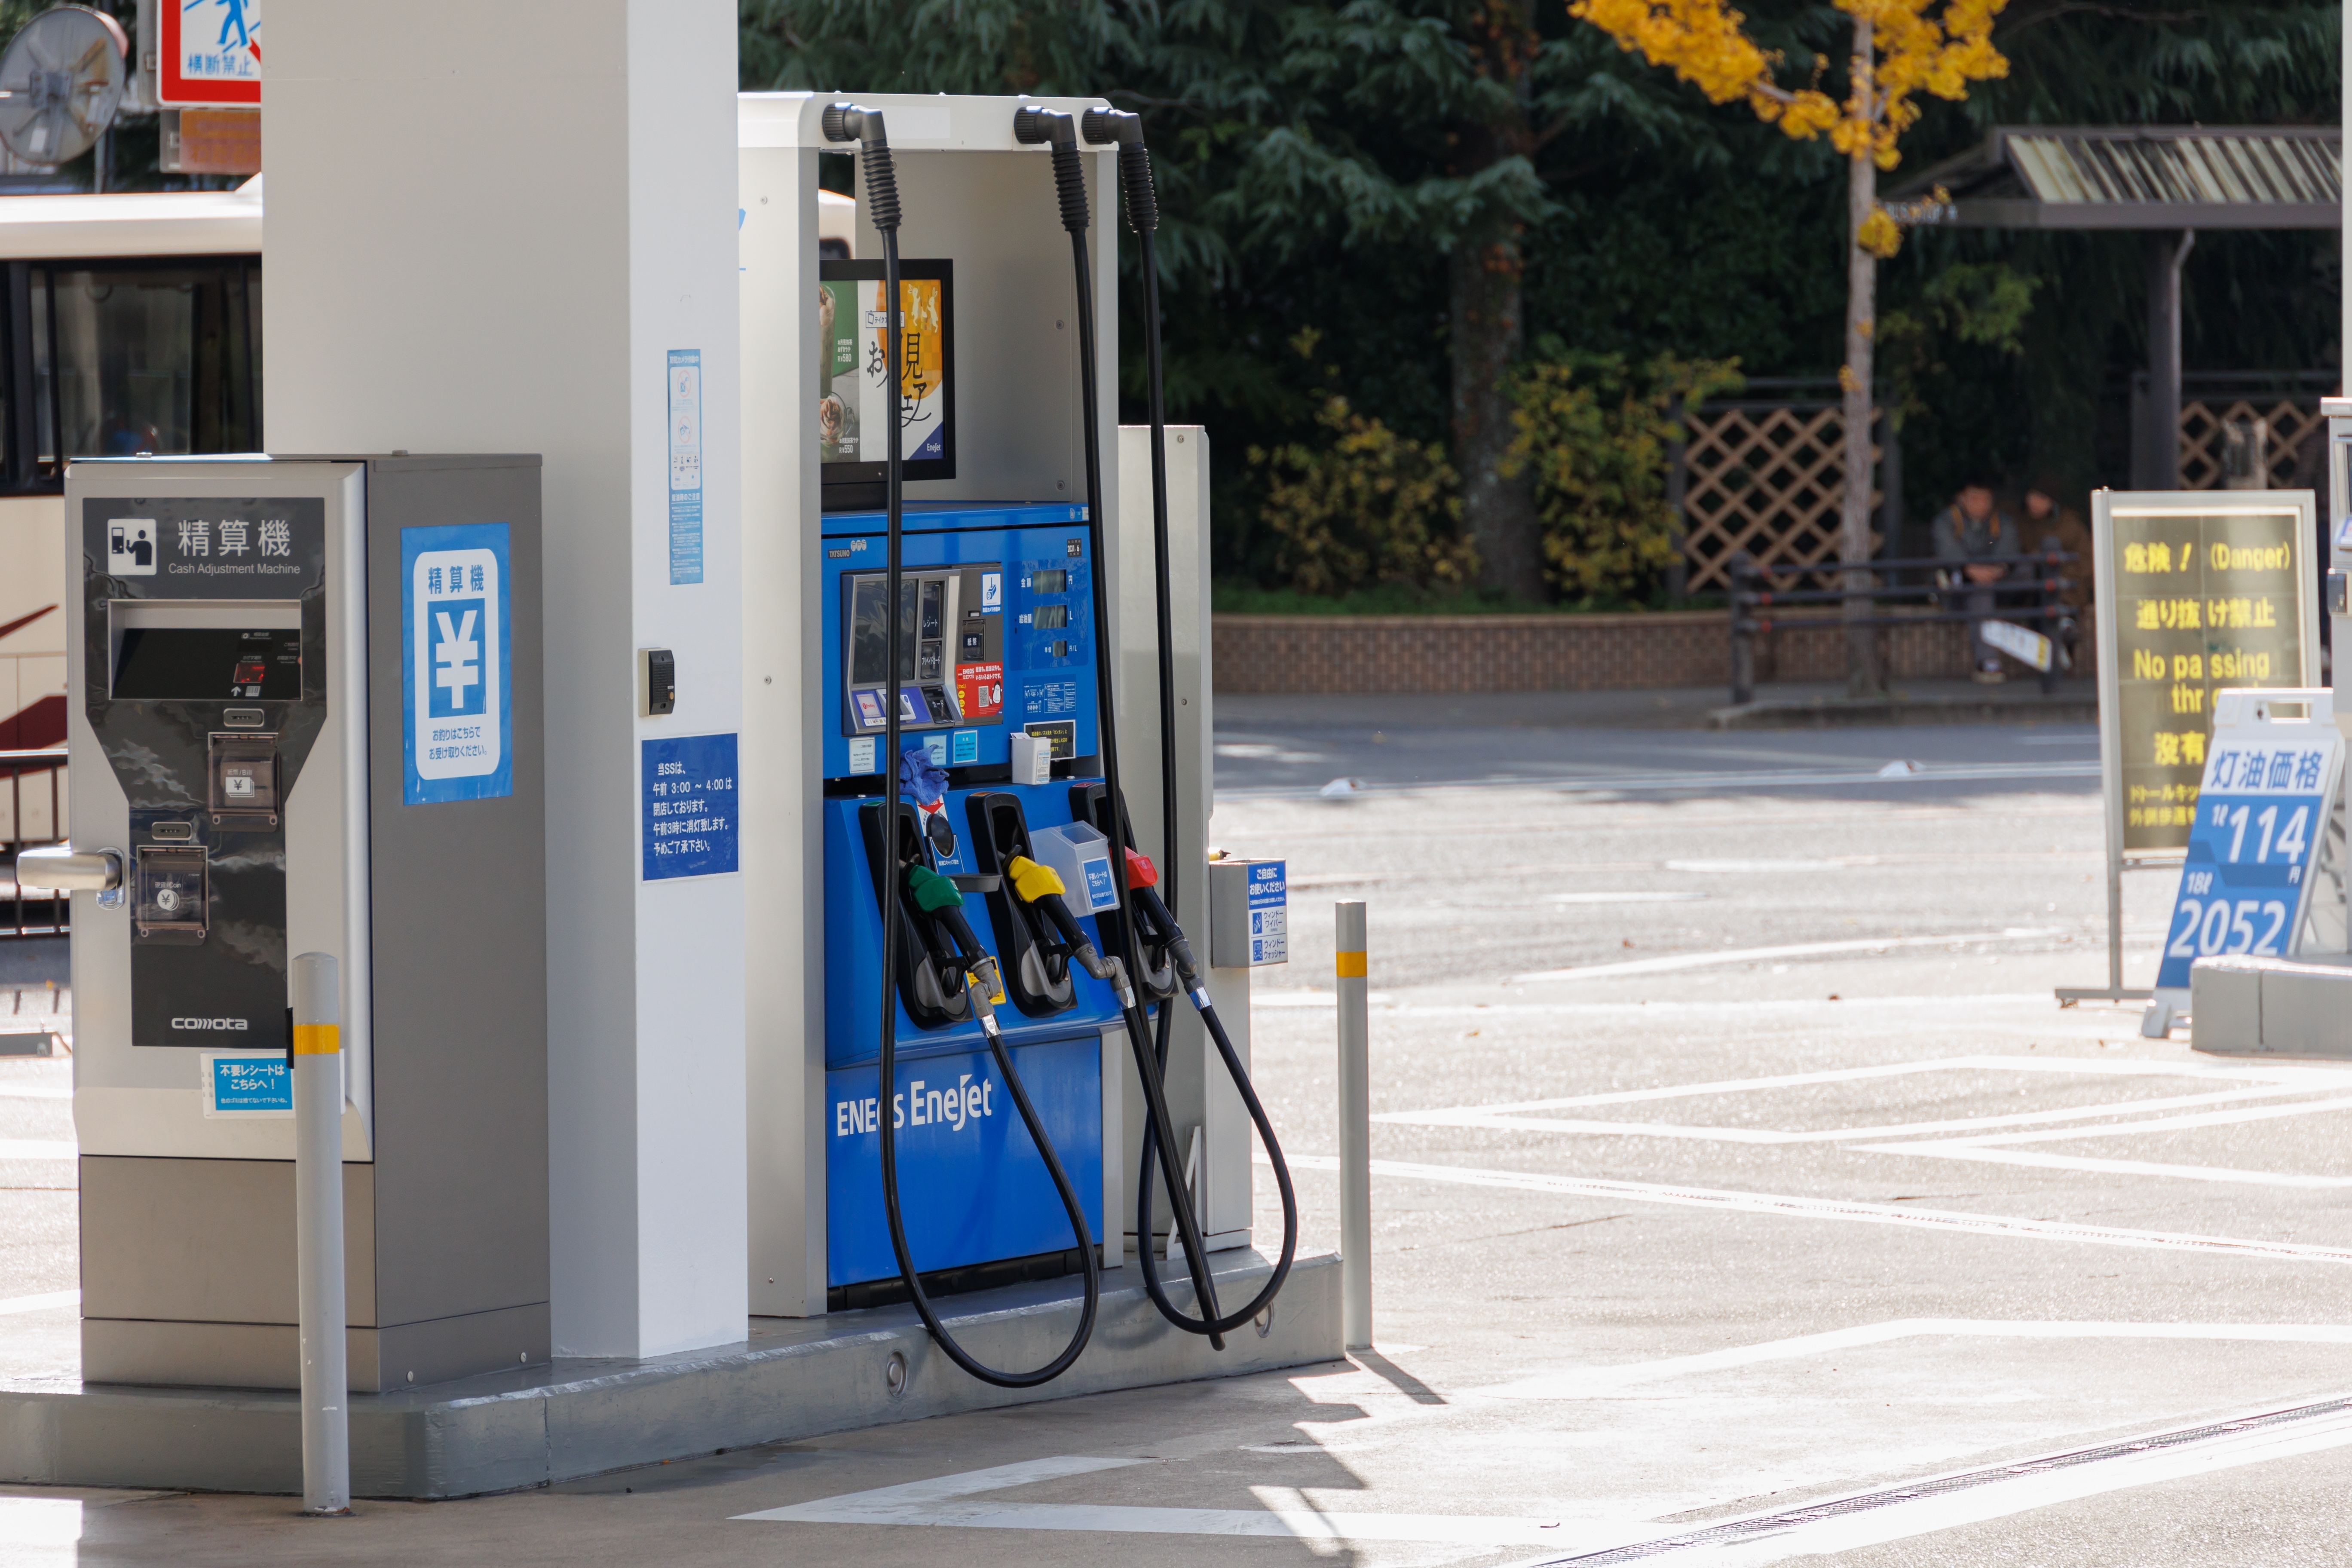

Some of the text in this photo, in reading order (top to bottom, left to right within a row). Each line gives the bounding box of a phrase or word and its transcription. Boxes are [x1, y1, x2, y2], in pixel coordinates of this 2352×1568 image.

[187, 52, 253, 76] 横断禁止
[178, 519, 291, 556] 精算機
[829, 549, 850, 557] TATSUNO
[168, 563, 300, 576] Cash Adjustment Machine
[428, 564, 484, 594] 精算機
[1069, 575, 1072, 585] 円
[923, 619, 937, 627] レシート
[2134, 648, 2165, 680] No
[932, 699, 944, 707] カード
[432, 726, 480, 741] お釣りはこちらで
[429, 744, 487, 760] お受け取りください。
[658, 761, 686, 775] 当SSは、
[2211, 750, 2322, 789] 灯油価格
[653, 799, 708, 816] 閉店しております。
[653, 816, 728, 836] 午前3時に消灯致します。
[654, 839, 710, 856] 予めご了承下さい。
[1257, 867, 1277, 879] ご自由に
[1250, 881, 1285, 895] お使いください
[1264, 910, 1283, 919] ウィンドー
[1265, 919, 1282, 928] ワイパー
[2168, 899, 2285, 957] 2052
[1264, 938, 1284, 949] ウィンドー
[1264, 949, 1285, 959] ウォッシャー
[220, 1064, 285, 1076] 不要レシートは
[837, 1094, 904, 1136] ENES
